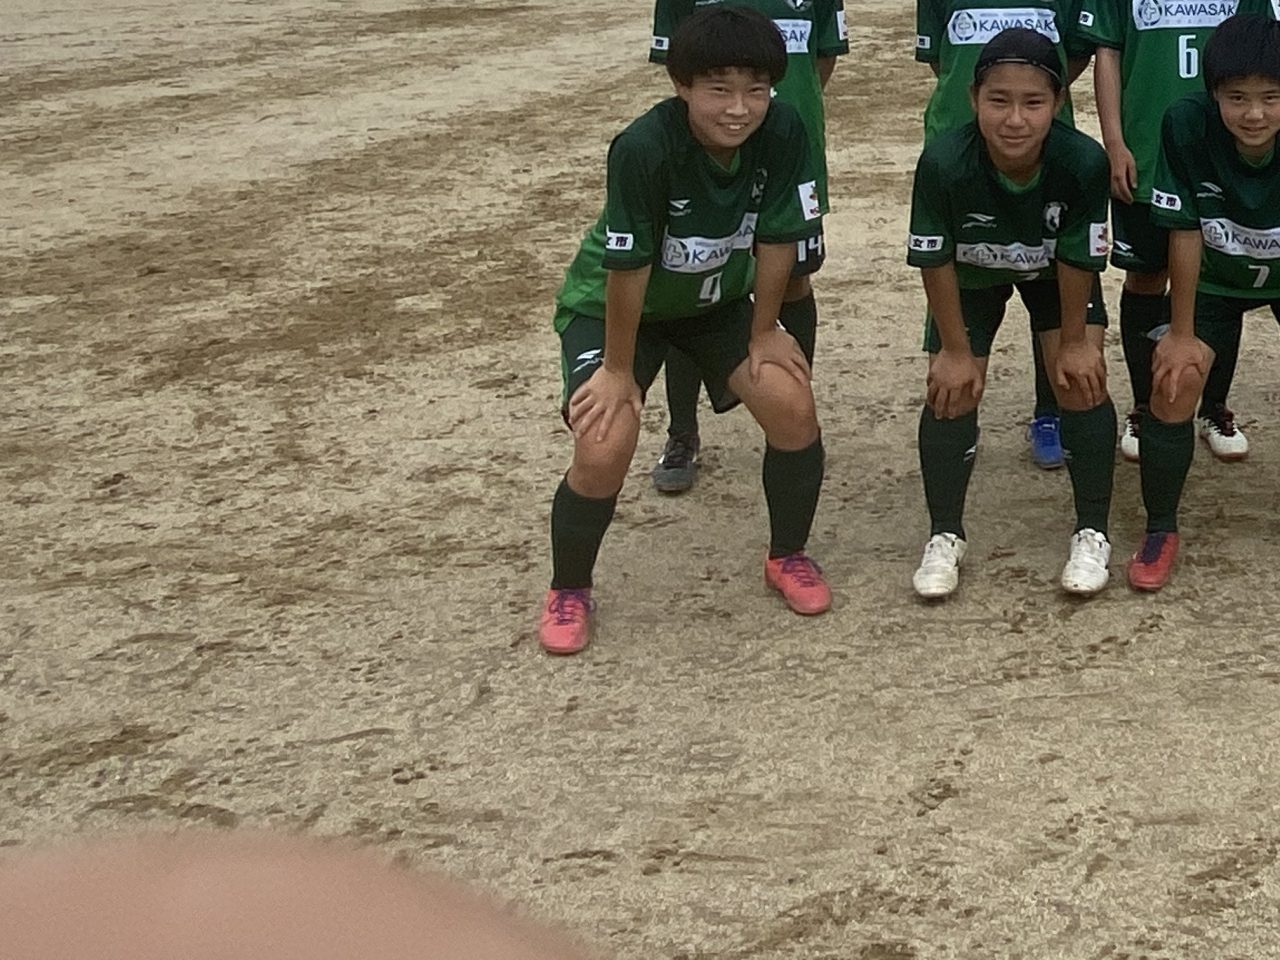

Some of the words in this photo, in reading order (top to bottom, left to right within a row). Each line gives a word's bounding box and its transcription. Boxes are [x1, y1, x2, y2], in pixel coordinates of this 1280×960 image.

[1178, 35, 1198, 79] 6
[797, 235, 822, 262] 14
[1248, 265, 1270, 288] 7
